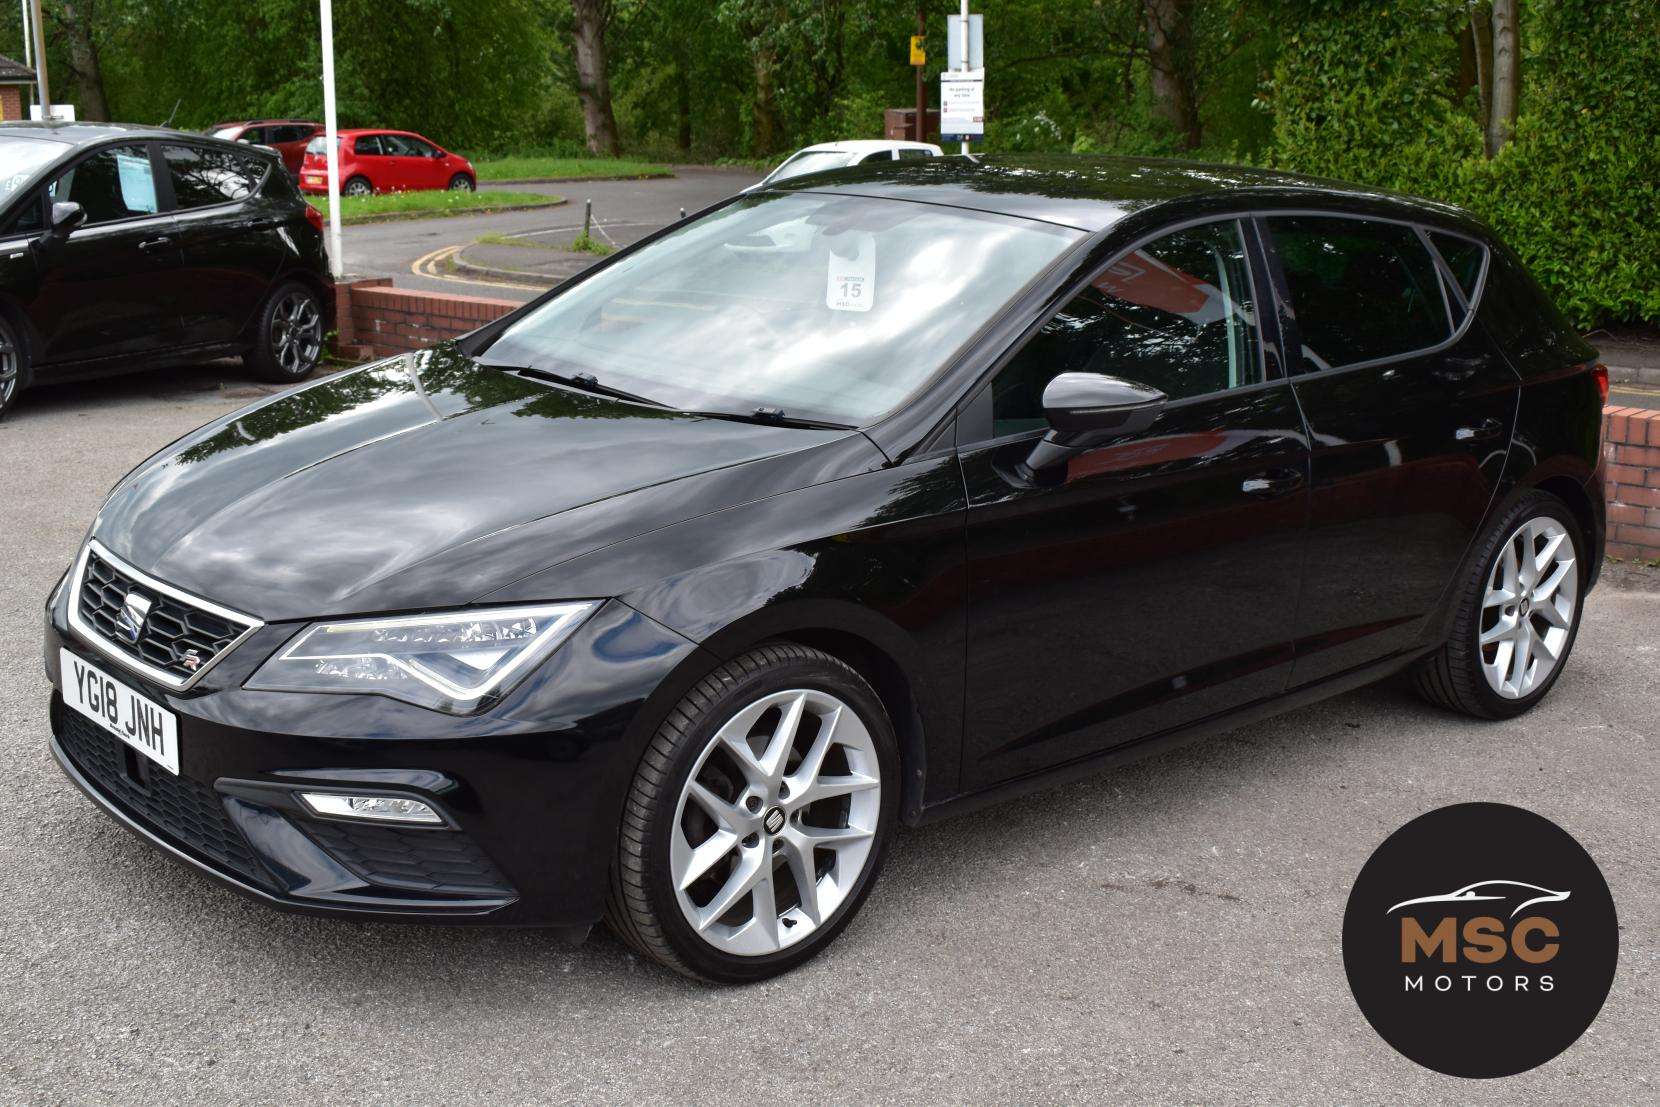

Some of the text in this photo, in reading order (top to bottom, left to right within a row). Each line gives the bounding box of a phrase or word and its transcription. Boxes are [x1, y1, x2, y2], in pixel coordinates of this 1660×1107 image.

[841, 282, 861, 298] 15
[74, 660, 164, 756] YG18 JNH
